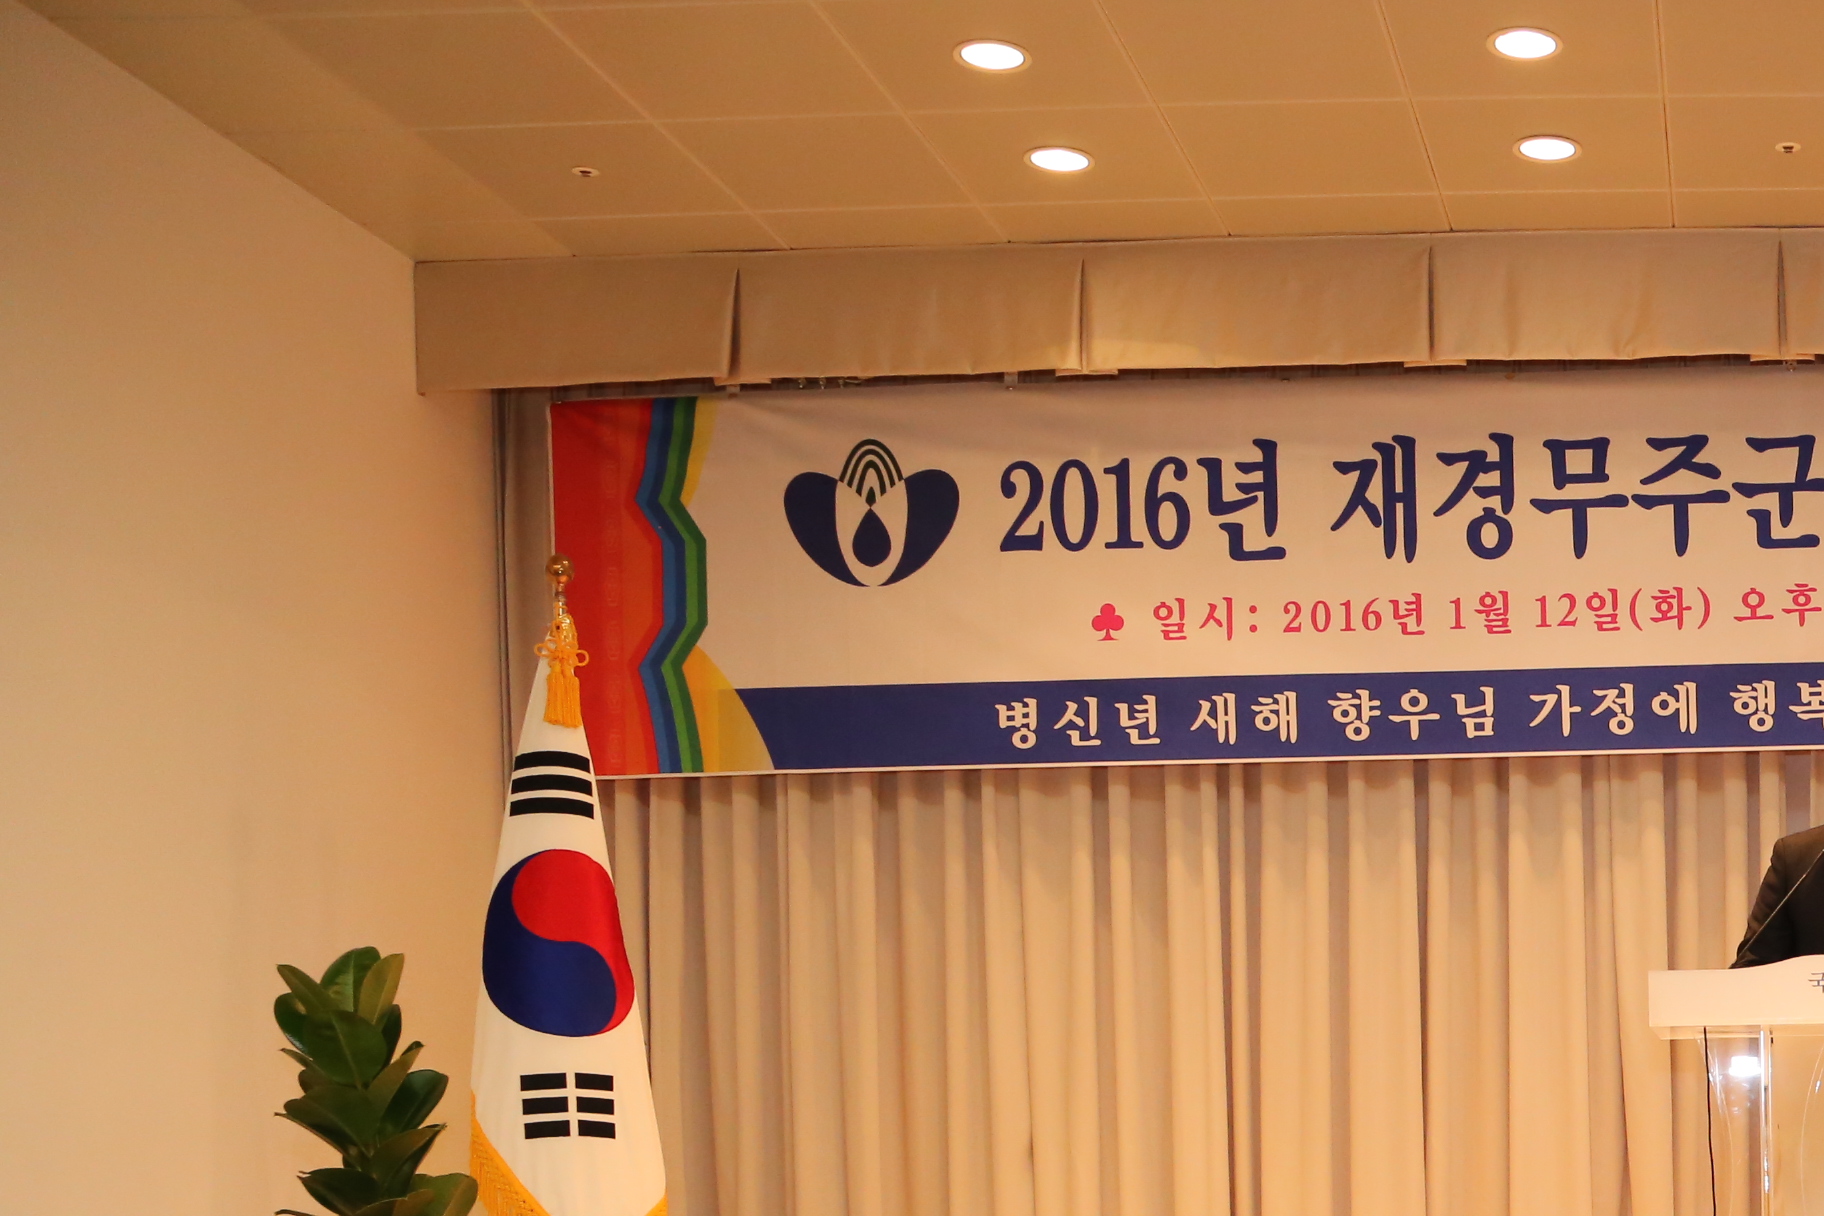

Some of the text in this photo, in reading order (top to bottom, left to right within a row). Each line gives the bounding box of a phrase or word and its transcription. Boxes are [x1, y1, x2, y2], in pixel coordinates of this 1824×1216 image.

[1000, 437, 1286, 561] 2016년
[1152, 596, 1259, 641] 일시:
[1283, 592, 1428, 637] 2016년
[1450, 589, 1513, 636] 1월
[1535, 586, 1712, 634] 12일(화)
[994, 694, 1161, 750] 병신년
[1190, 691, 1299, 745] 새해
[1328, 686, 1496, 741] 향우님
[1528, 681, 1699, 737] 가정에
